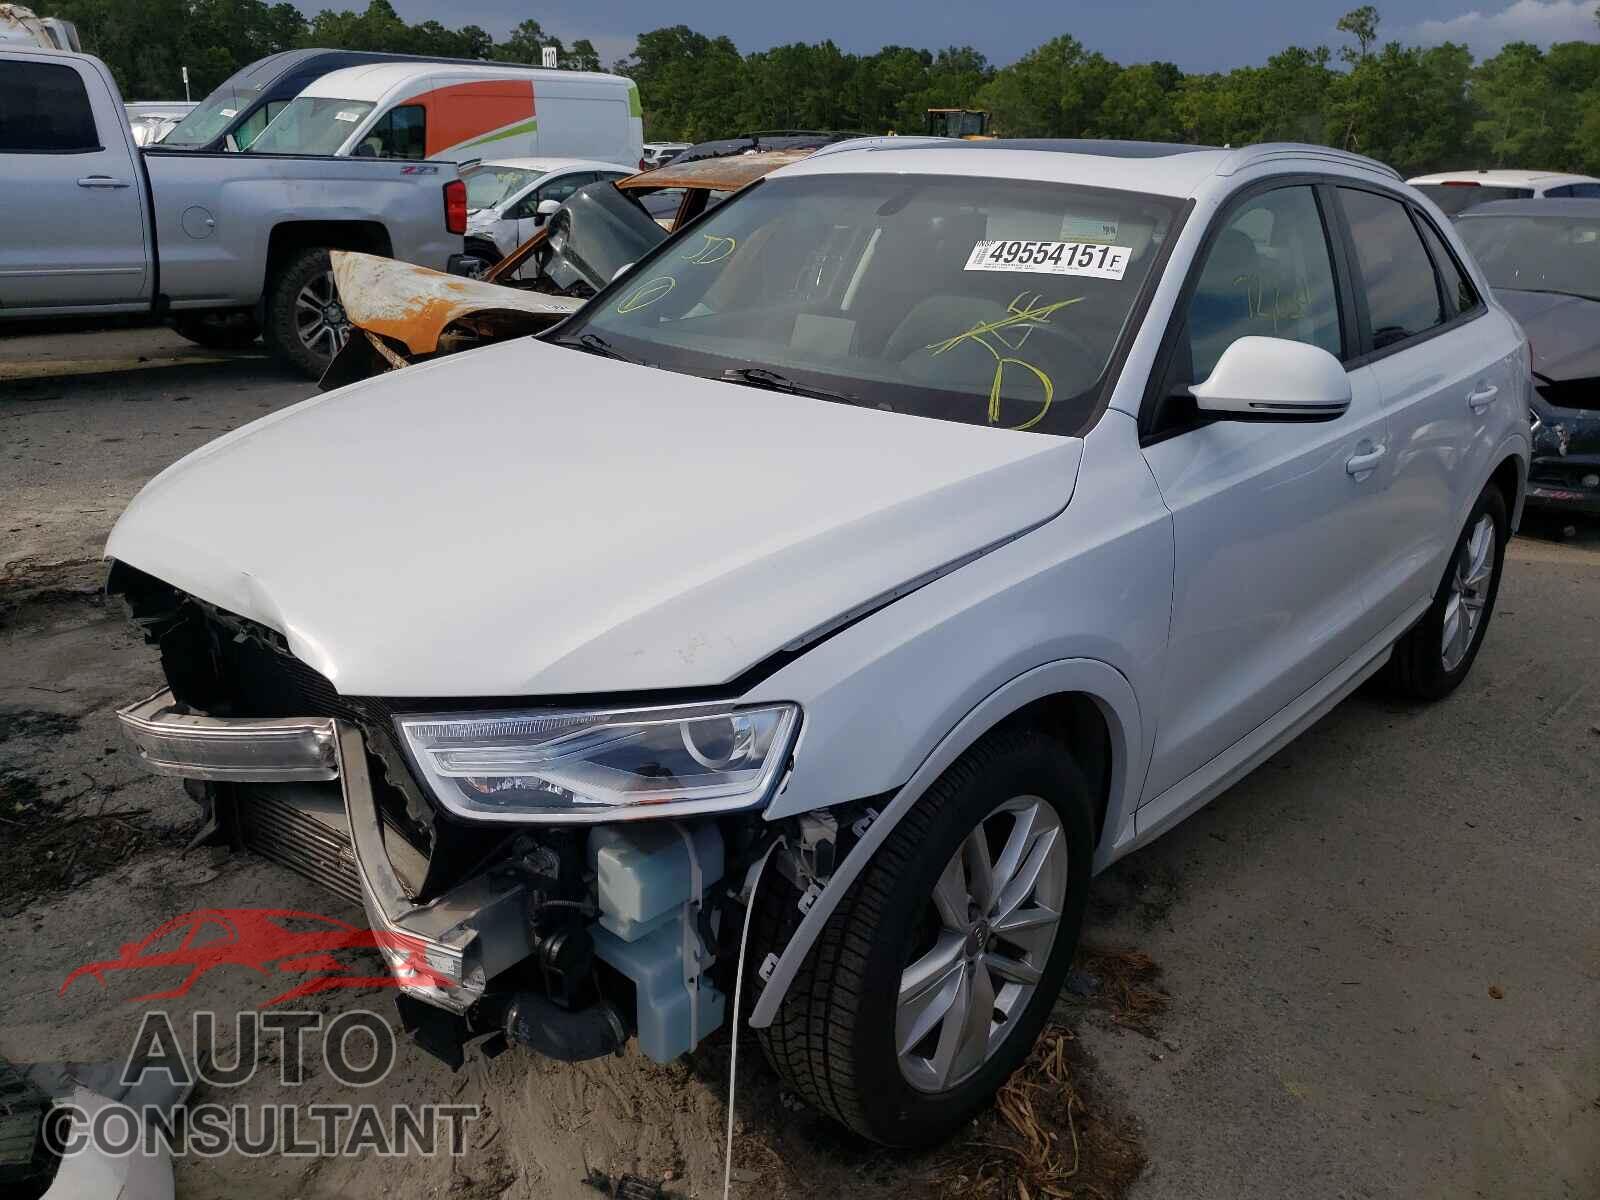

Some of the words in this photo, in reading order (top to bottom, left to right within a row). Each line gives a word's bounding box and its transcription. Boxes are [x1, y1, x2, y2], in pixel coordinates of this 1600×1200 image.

[544, 50, 557, 68] 110
[989, 241, 1110, 269] 49554151
[1109, 255, 1122, 268] F
